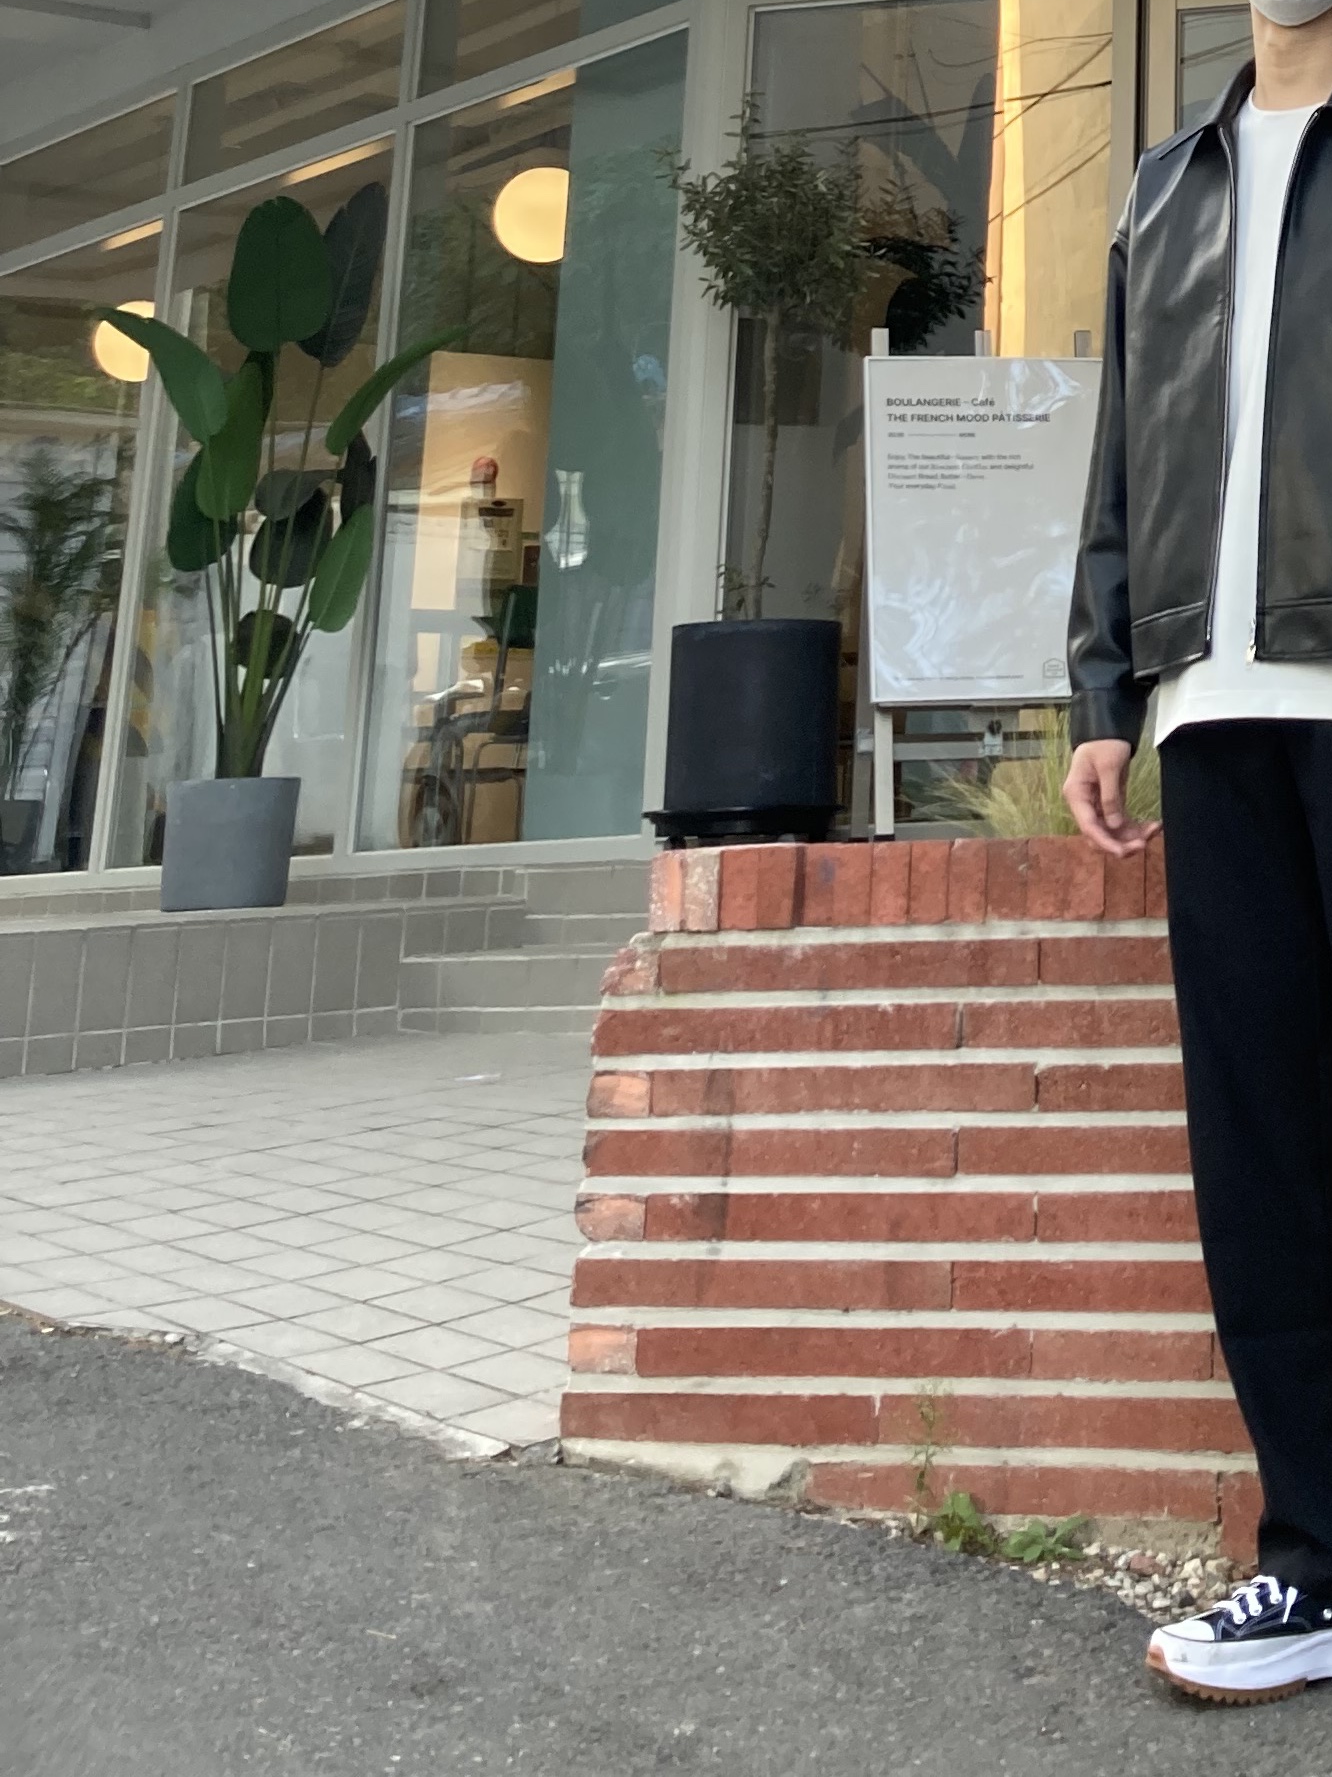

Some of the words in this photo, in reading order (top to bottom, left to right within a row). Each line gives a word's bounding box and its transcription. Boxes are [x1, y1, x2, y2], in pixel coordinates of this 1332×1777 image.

[886, 398, 961, 407] BOULANGERIE
[971, 397, 995, 407] Café
[887, 413, 908, 422] THE
[910, 413, 954, 422] FRENCH
[956, 413, 989, 422] MOOD
